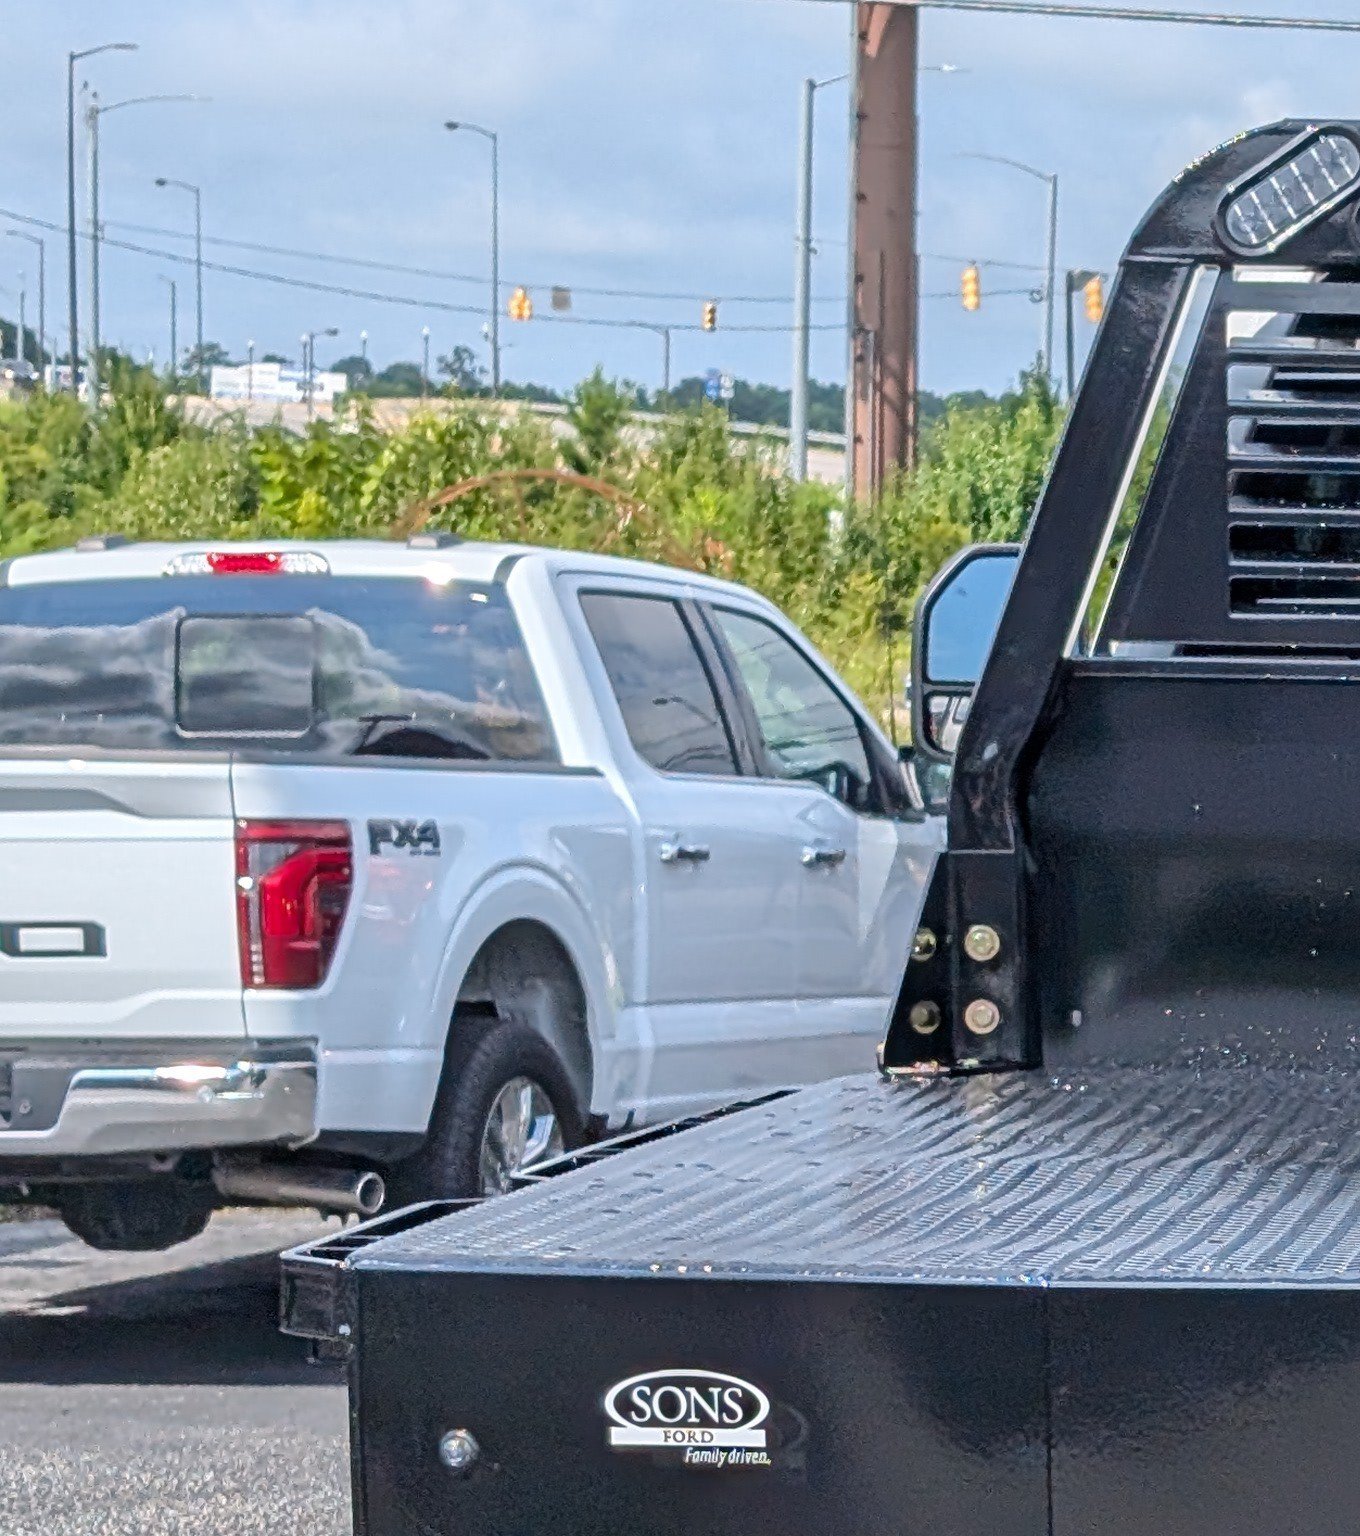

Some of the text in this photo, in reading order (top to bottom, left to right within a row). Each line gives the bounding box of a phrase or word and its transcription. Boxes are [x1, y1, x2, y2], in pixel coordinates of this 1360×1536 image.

[366, 818, 441, 855] FX4
[630, 1385, 744, 1424] SONS
[663, 1430, 714, 1444] FORD
[684, 1446, 728, 1468] Family
